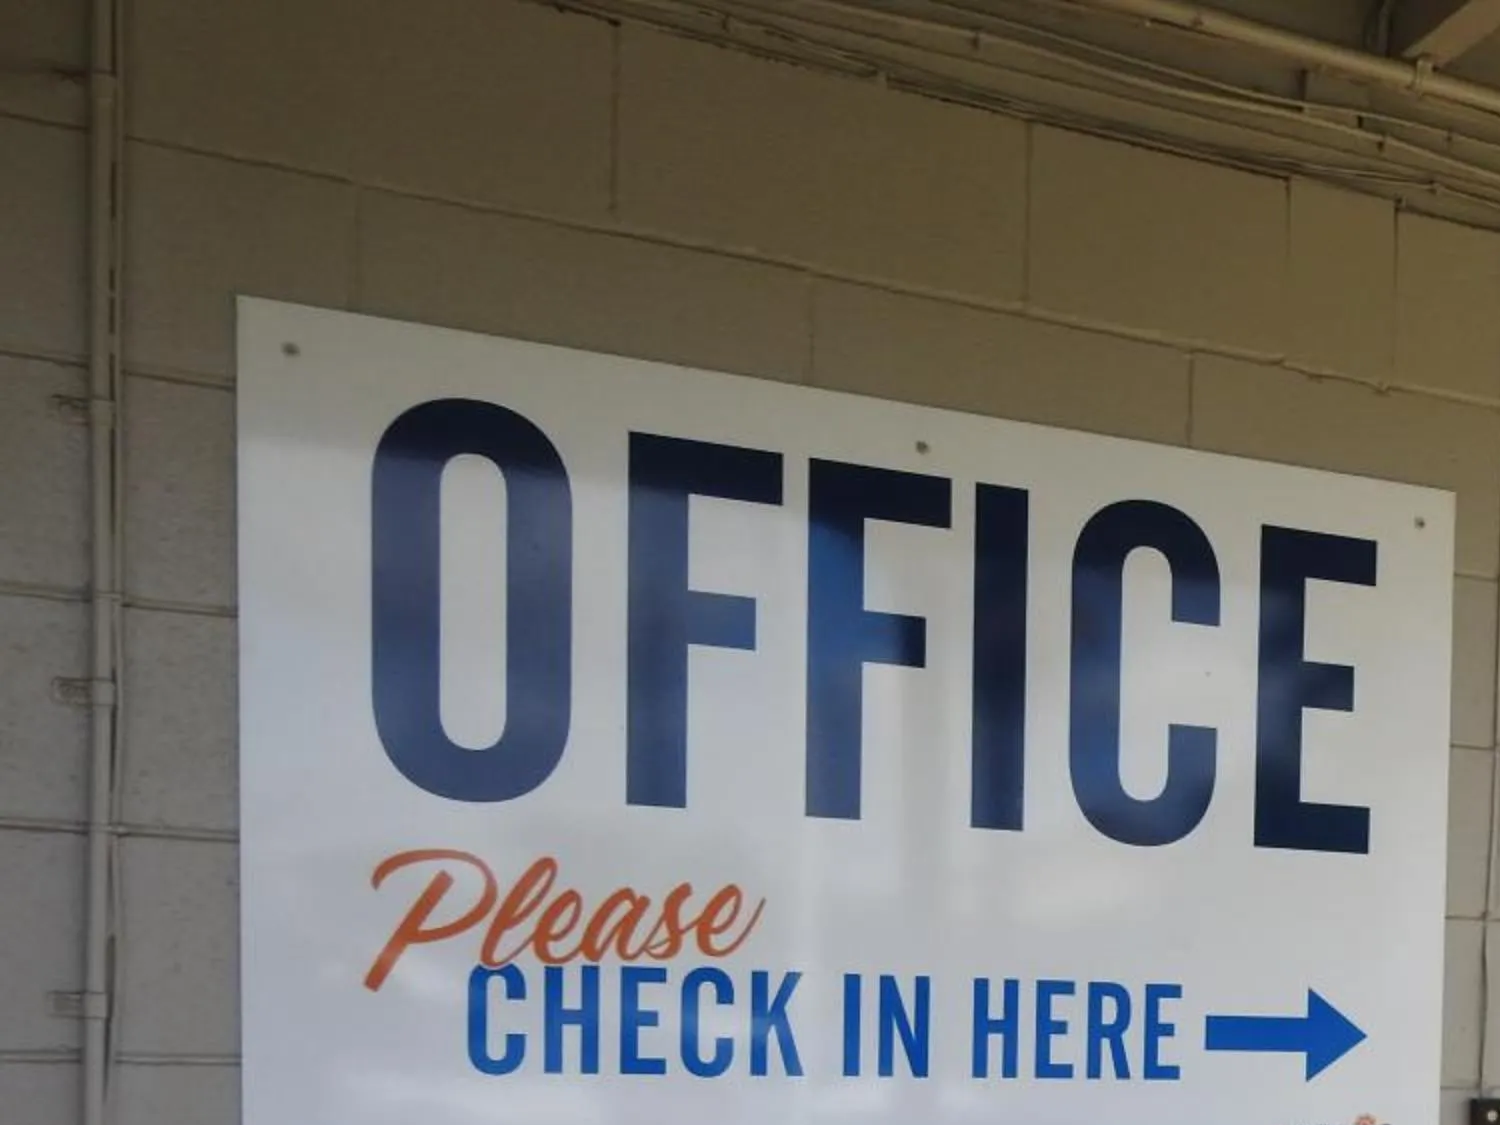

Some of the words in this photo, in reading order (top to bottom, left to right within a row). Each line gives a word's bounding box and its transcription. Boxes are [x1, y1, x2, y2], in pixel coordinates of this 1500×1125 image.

[371, 398, 1378, 855] OFFICE
[362, 848, 765, 992] Please
[467, 963, 803, 1075] CHECK
[842, 973, 930, 1078] IN
[972, 977, 1183, 1080] HERE
